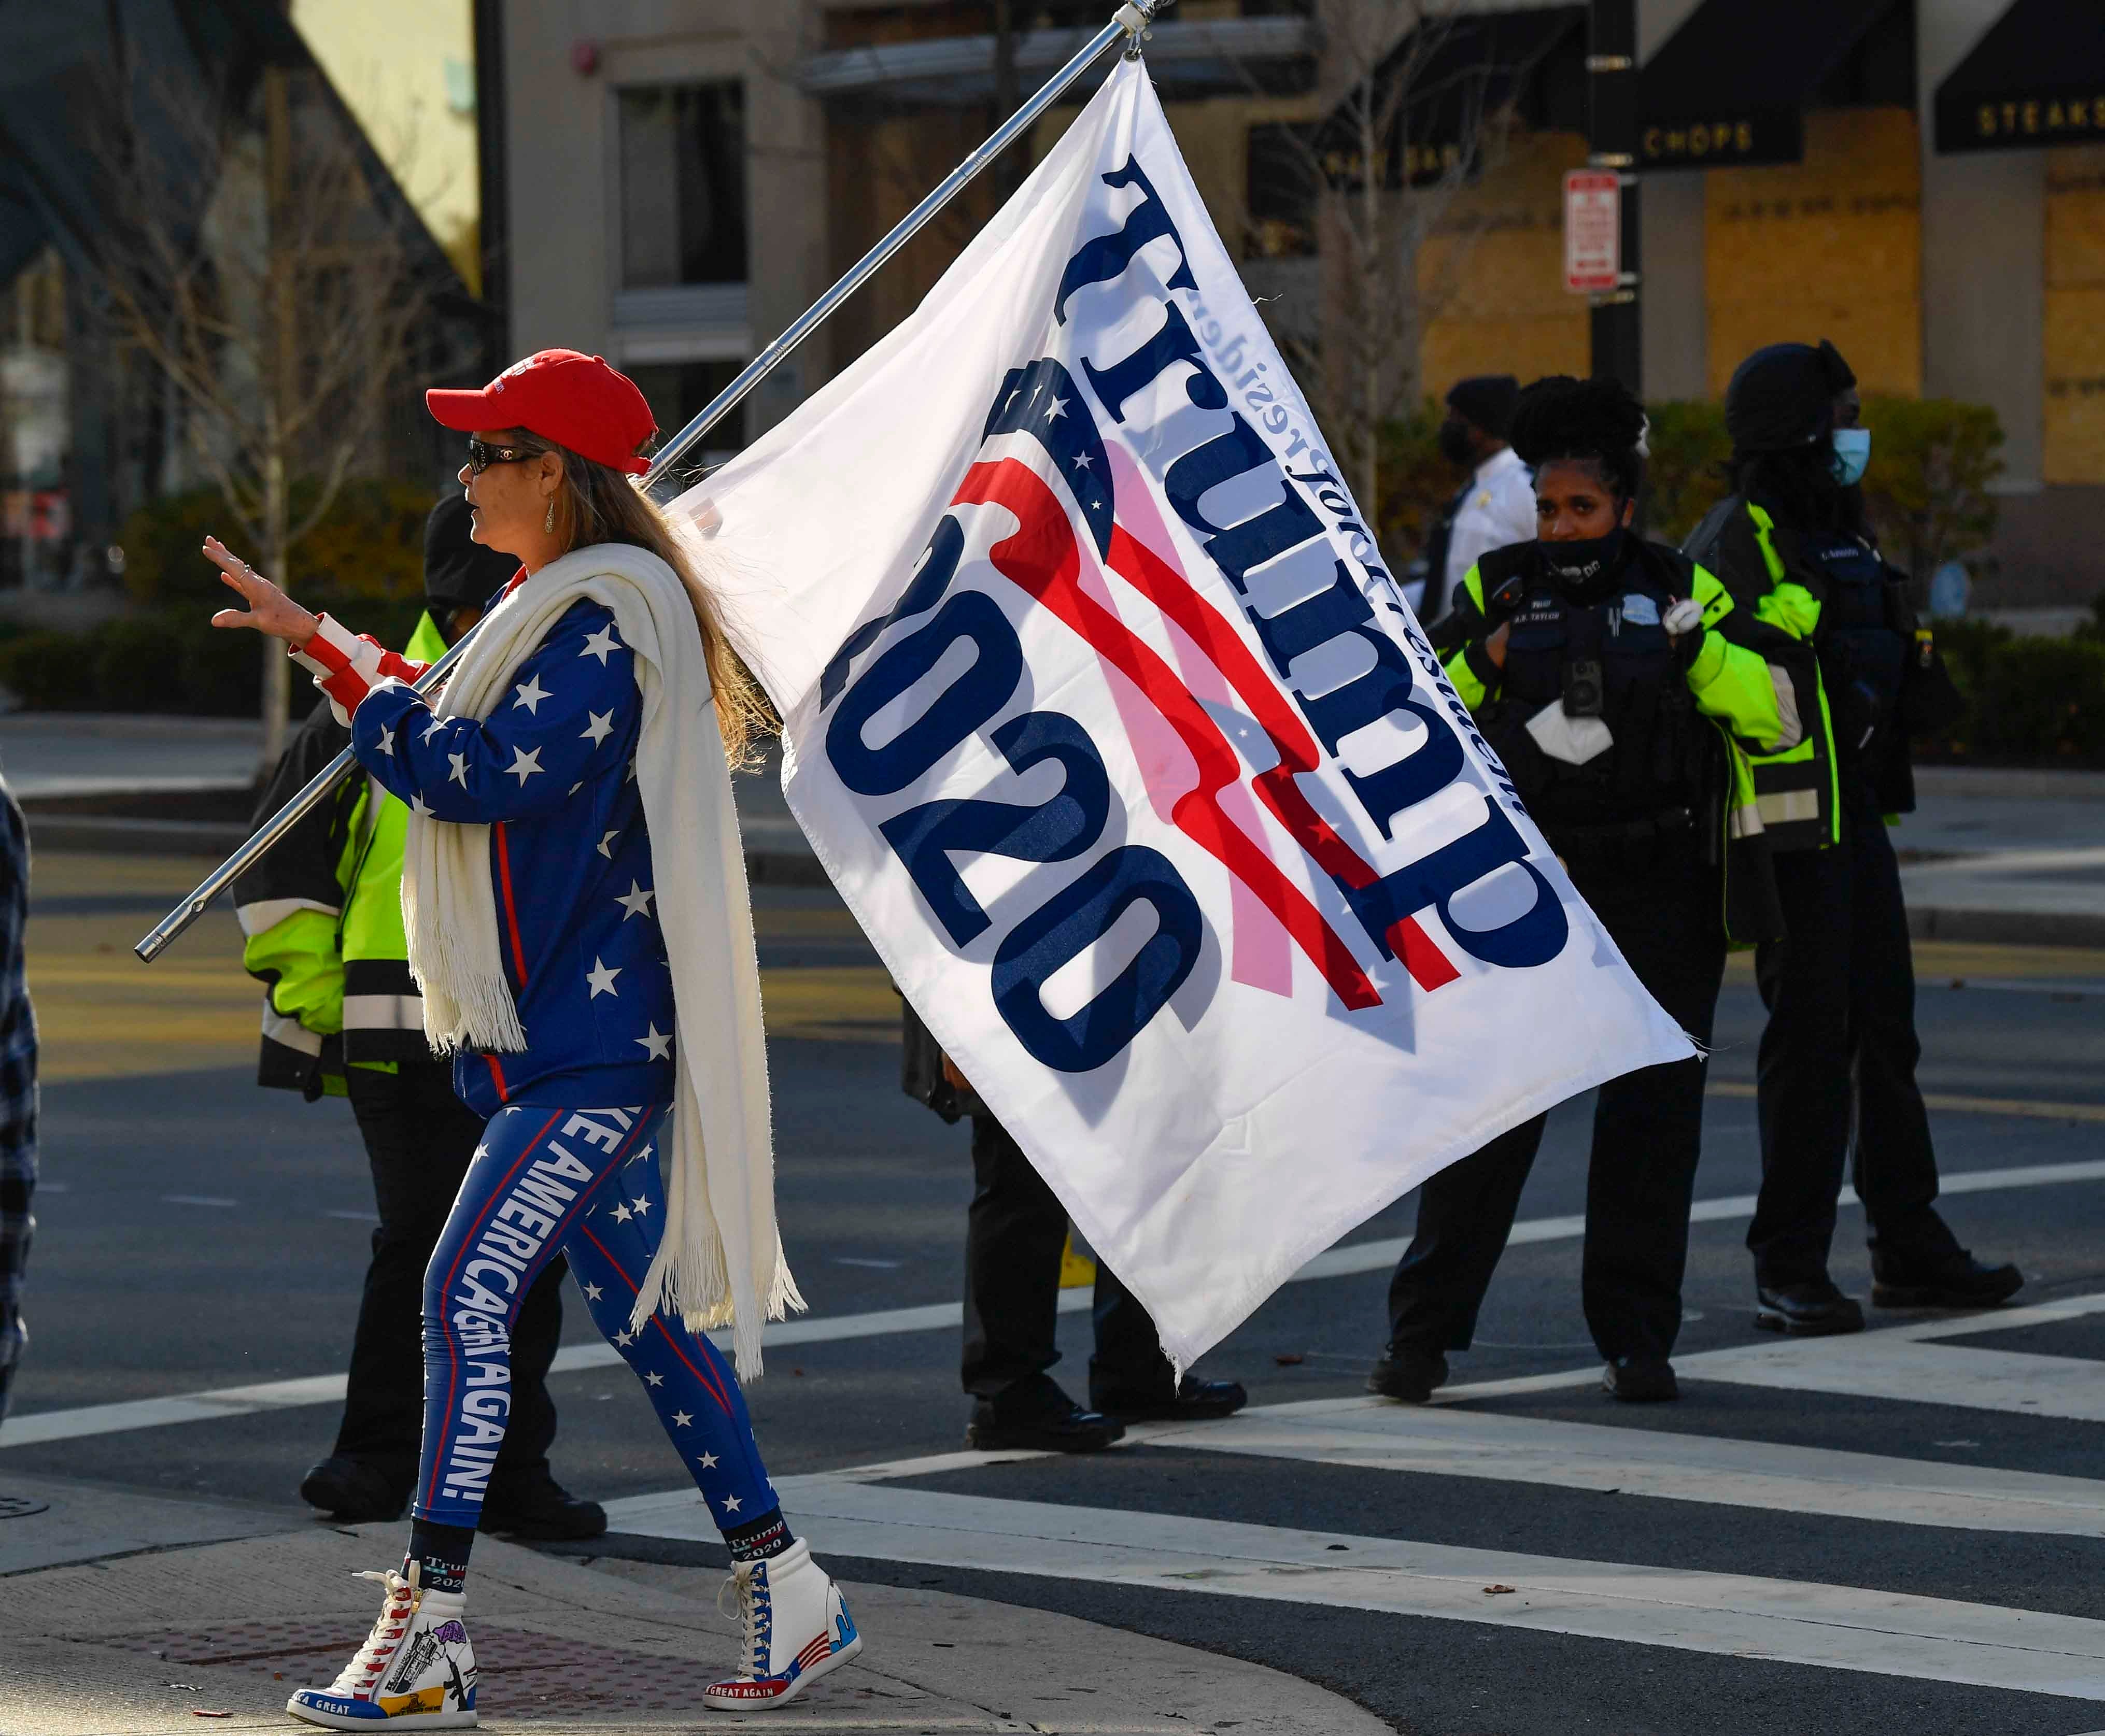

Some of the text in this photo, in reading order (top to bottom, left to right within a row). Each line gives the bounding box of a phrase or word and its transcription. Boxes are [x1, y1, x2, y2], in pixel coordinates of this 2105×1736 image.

[1976, 97, 2105, 136] STEAKS
[1644, 123, 1751, 158] CHOPS
[1285, 465, 1372, 544] for
[1054, 153, 1569, 968] Trump
[455, 1141, 594, 1315] AMERICA
[442, 1361, 512, 1501] AGAIN!
[728, 1520, 783, 1548] Trump
[742, 1538, 782, 1559] 2020
[316, 1699, 350, 1715] GREAT
[710, 1686, 774, 1697] GREAT AGAIN
